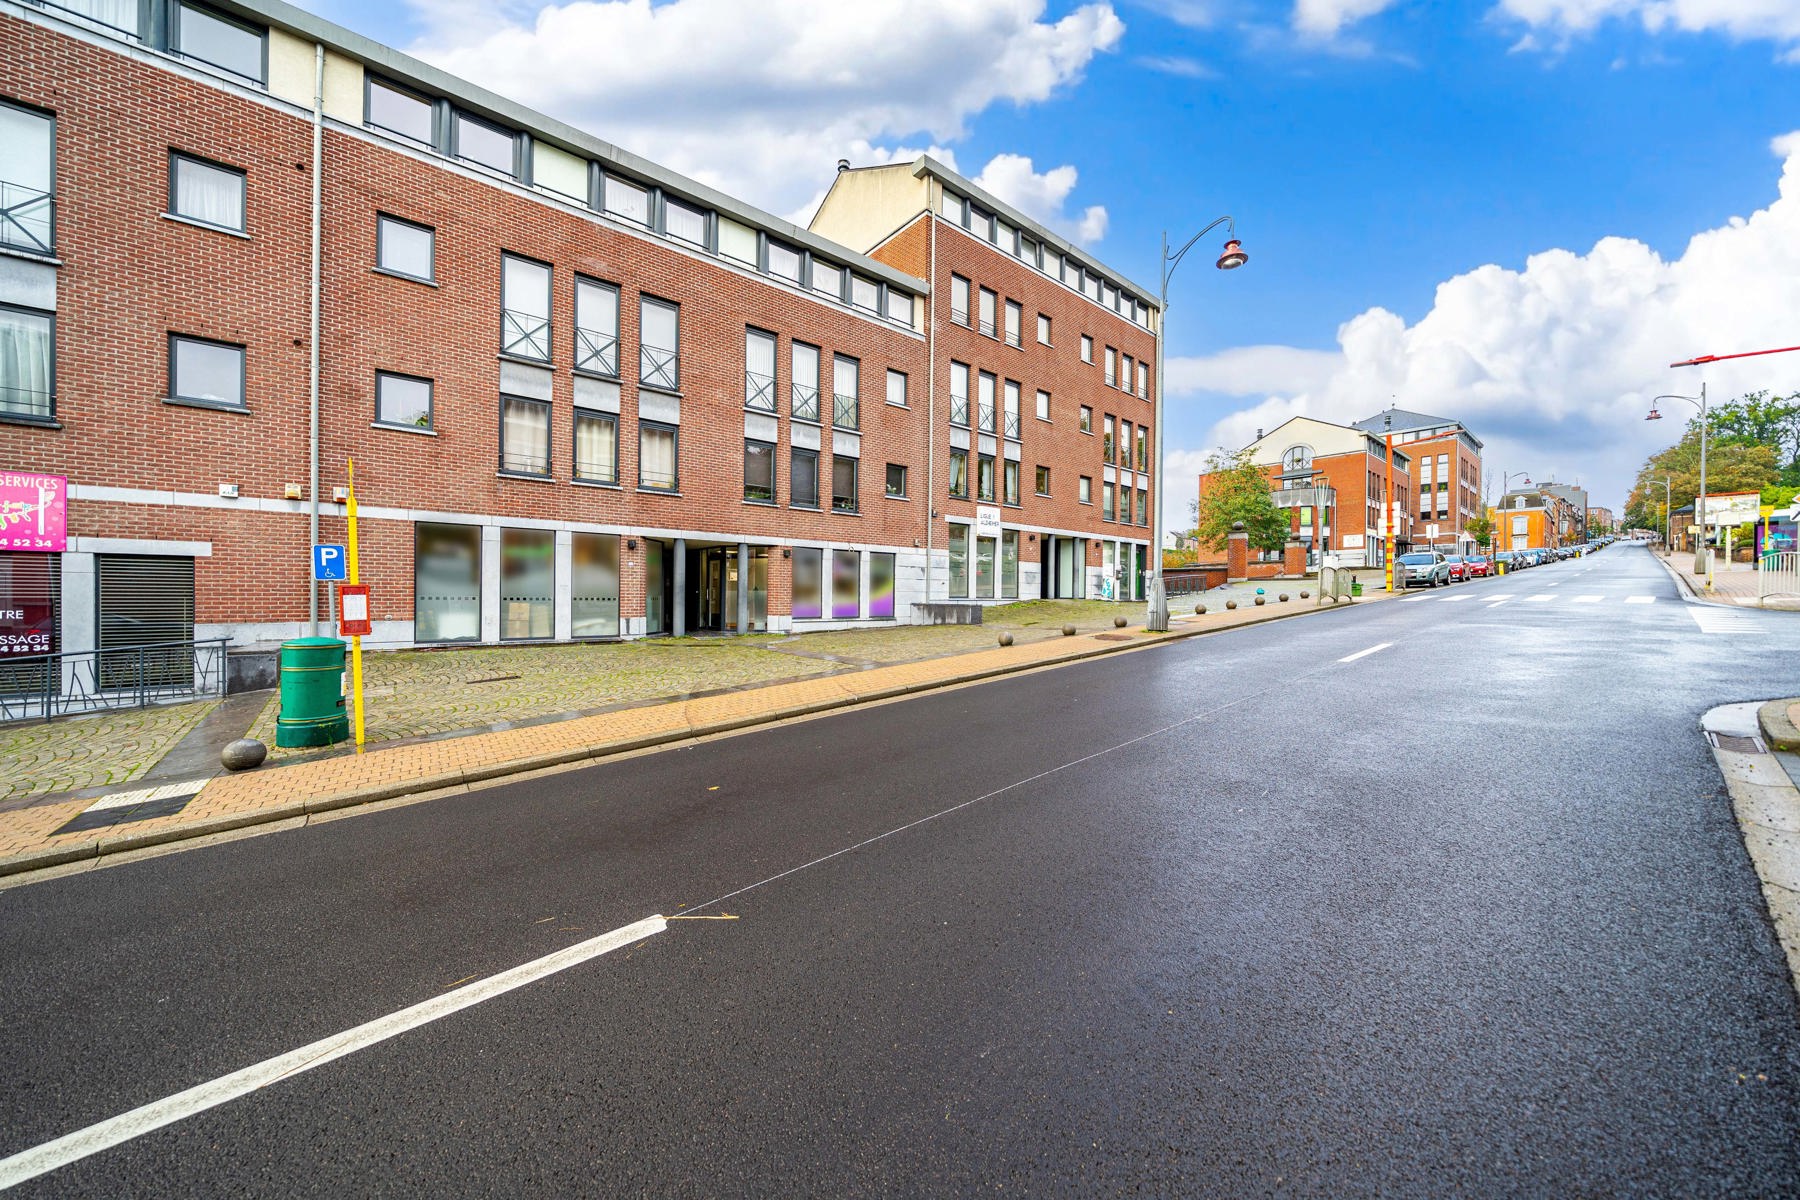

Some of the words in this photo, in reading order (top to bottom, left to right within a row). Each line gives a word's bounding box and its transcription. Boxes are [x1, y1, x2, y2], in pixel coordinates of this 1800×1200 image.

[0, 475, 58, 489] SERVICES
[13, 539, 31, 547] 52
[35, 540, 53, 548] 34
[321, 547, 338, 567] P
[33, 644, 50, 652] 34
